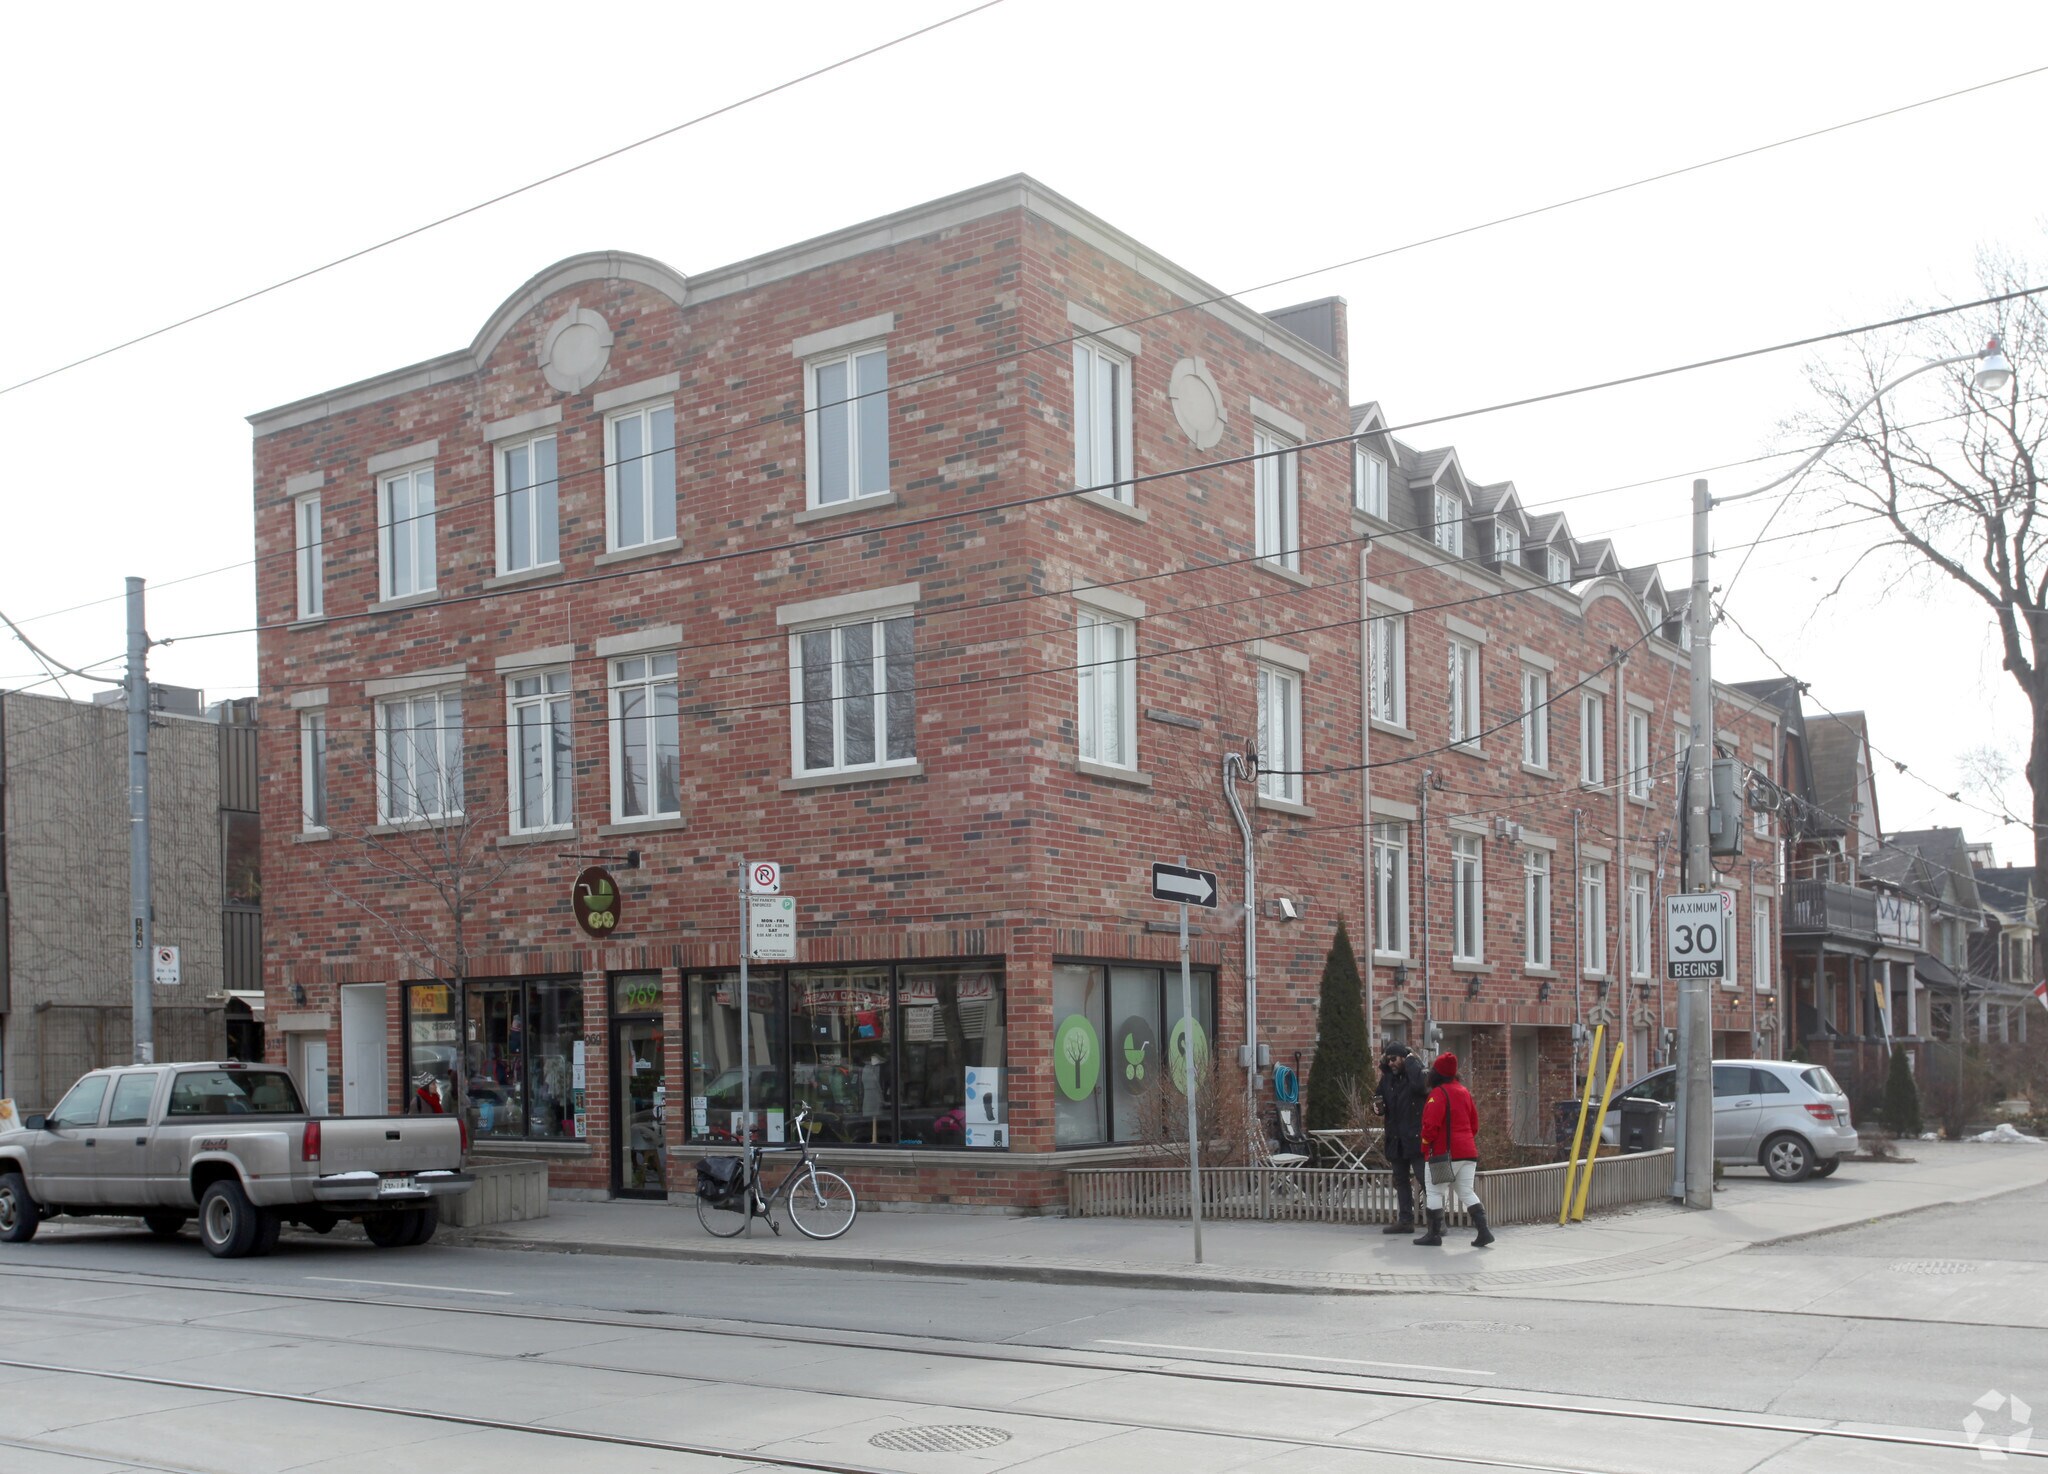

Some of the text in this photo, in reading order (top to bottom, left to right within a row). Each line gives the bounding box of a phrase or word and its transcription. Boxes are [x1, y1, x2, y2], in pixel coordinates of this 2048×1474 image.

[1671, 902, 1717, 914] MAXIMUM
[1674, 924, 1717, 955] 30
[1674, 962, 1717, 977] BEGINS
[626, 983, 657, 1005] 969
